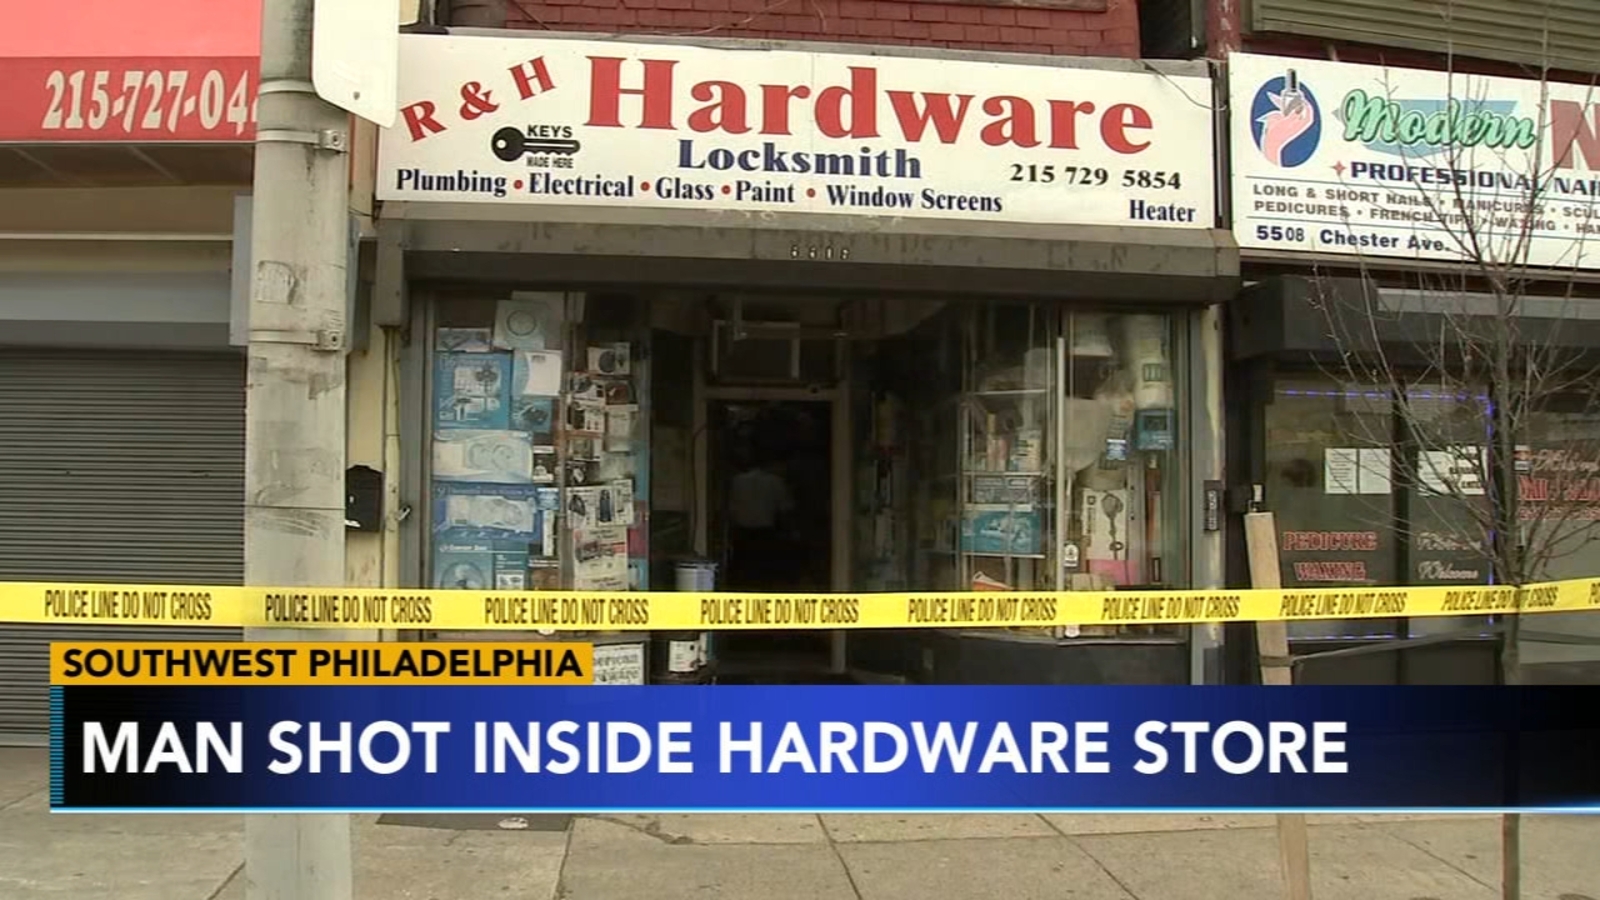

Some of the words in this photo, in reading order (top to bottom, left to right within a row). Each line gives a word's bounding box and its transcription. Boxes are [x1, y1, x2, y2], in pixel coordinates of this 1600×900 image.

[41, 69, 259, 136] 215-727-04
[400, 100, 447, 142] R
[459, 80, 500, 120] &
[507, 55, 556, 100] H
[583, 55, 1154, 155] Hardware
[526, 125, 573, 138] KEYS
[1341, 88, 1536, 149] Modern
[526, 156, 549, 168] MADE
[552, 156, 574, 169] HERE
[678, 138, 921, 179] Locksmith
[1010, 163, 1055, 183] 215
[1064, 166, 1109, 186] 729
[1122, 169, 1182, 190] 5854
[396, 168, 507, 198] Plumbing
[528, 172, 634, 198] Electrical
[655, 176, 715, 201] Glass
[735, 180, 795, 203] Paint
[826, 184, 914, 210] Window
[921, 187, 1003, 212] Screens
[1253, 184, 1298, 197] LONG
[1306, 188, 1317, 198] &
[1325, 189, 1379, 203] SHORT
[1129, 199, 1196, 222] Heater
[1254, 200, 1350, 218] PEDICURES
[1370, 208, 1438, 222] FRENCH
[1256, 225, 1305, 242] 5508
[1320, 229, 1399, 248] Chester
[1407, 234, 1451, 251] Ave.
[1283, 531, 1378, 551] PEDICURE
[45, 590, 88, 618] POLICE
[91, 590, 119, 618] LINE
[122, 591, 140, 618] DO
[142, 592, 168, 619] NOT
[170, 592, 211, 620] CROSS
[265, 594, 309, 622] POLICE
[311, 595, 339, 622] LINE
[342, 595, 359, 622] DO
[363, 596, 388, 623] NOT
[391, 596, 432, 624] CROSS
[485, 597, 527, 624] POLICE
[531, 598, 558, 624] LINE
[561, 598, 579, 624] DO
[582, 598, 606, 624] NOT
[608, 598, 649, 625] CROSS
[700, 598, 742, 624] POLICE
[745, 598, 772, 624] LINE
[775, 599, 791, 624] DO
[794, 599, 818, 624] NOT
[820, 598, 859, 624] CROSS
[907, 598, 947, 623] POLICE
[950, 598, 975, 622] LINE
[977, 598, 993, 622] DO
[997, 598, 1019, 621] NOT
[1020, 598, 1057, 621] CROSS
[1101, 597, 1138, 621] POLICE
[1141, 597, 1164, 620] LINE
[1166, 597, 1181, 619] DO
[1184, 597, 1204, 618] NOT
[1205, 596, 1240, 618] CROSS
[1280, 595, 1315, 616] POLICE
[1318, 594, 1340, 615] LINE
[1341, 594, 1354, 614] DO
[1355, 593, 1376, 614] NOT
[1375, 592, 1408, 612] CROSS
